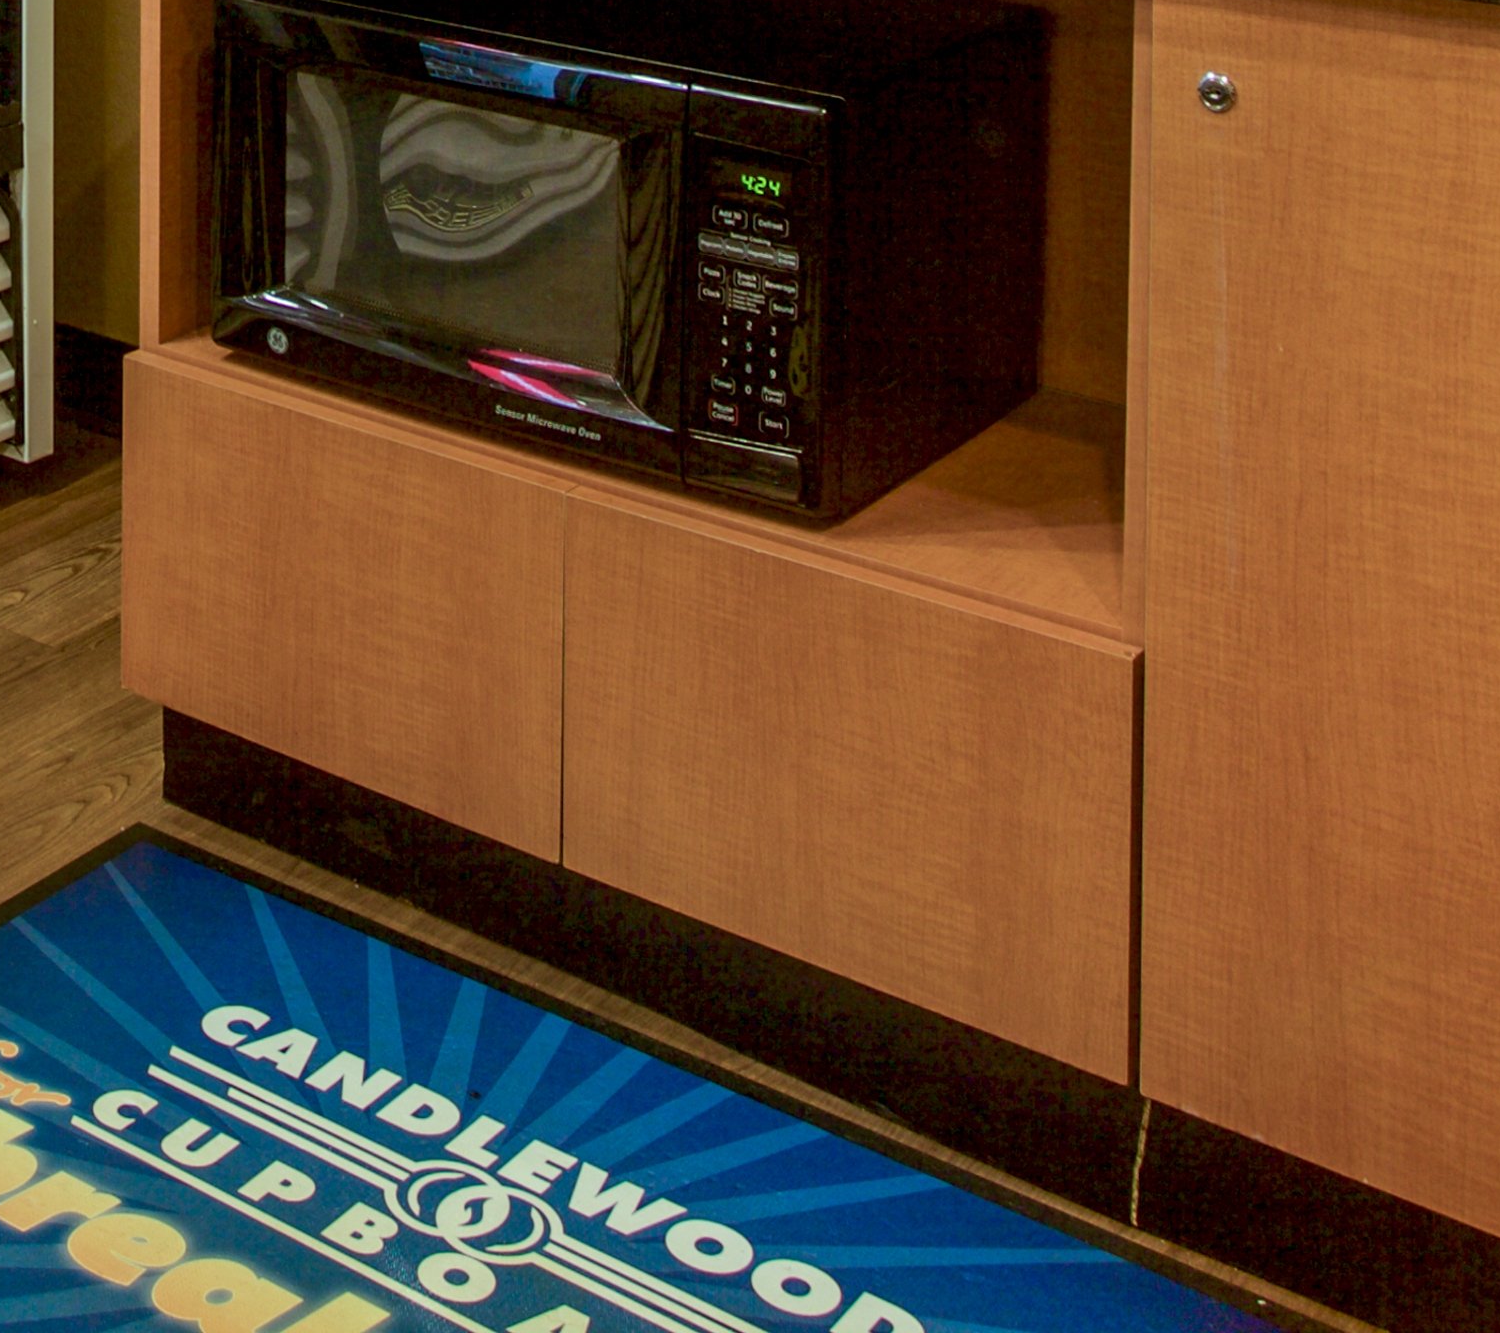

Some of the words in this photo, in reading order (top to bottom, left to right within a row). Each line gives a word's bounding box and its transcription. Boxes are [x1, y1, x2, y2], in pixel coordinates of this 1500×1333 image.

[741, 173, 781, 197] 4:24
[495, 404, 525, 421] Sensor
[527, 413, 577, 435] Microwave
[578, 426, 602, 442] Oven
[200, 1006, 925, 1333] CANDLEWOOD
